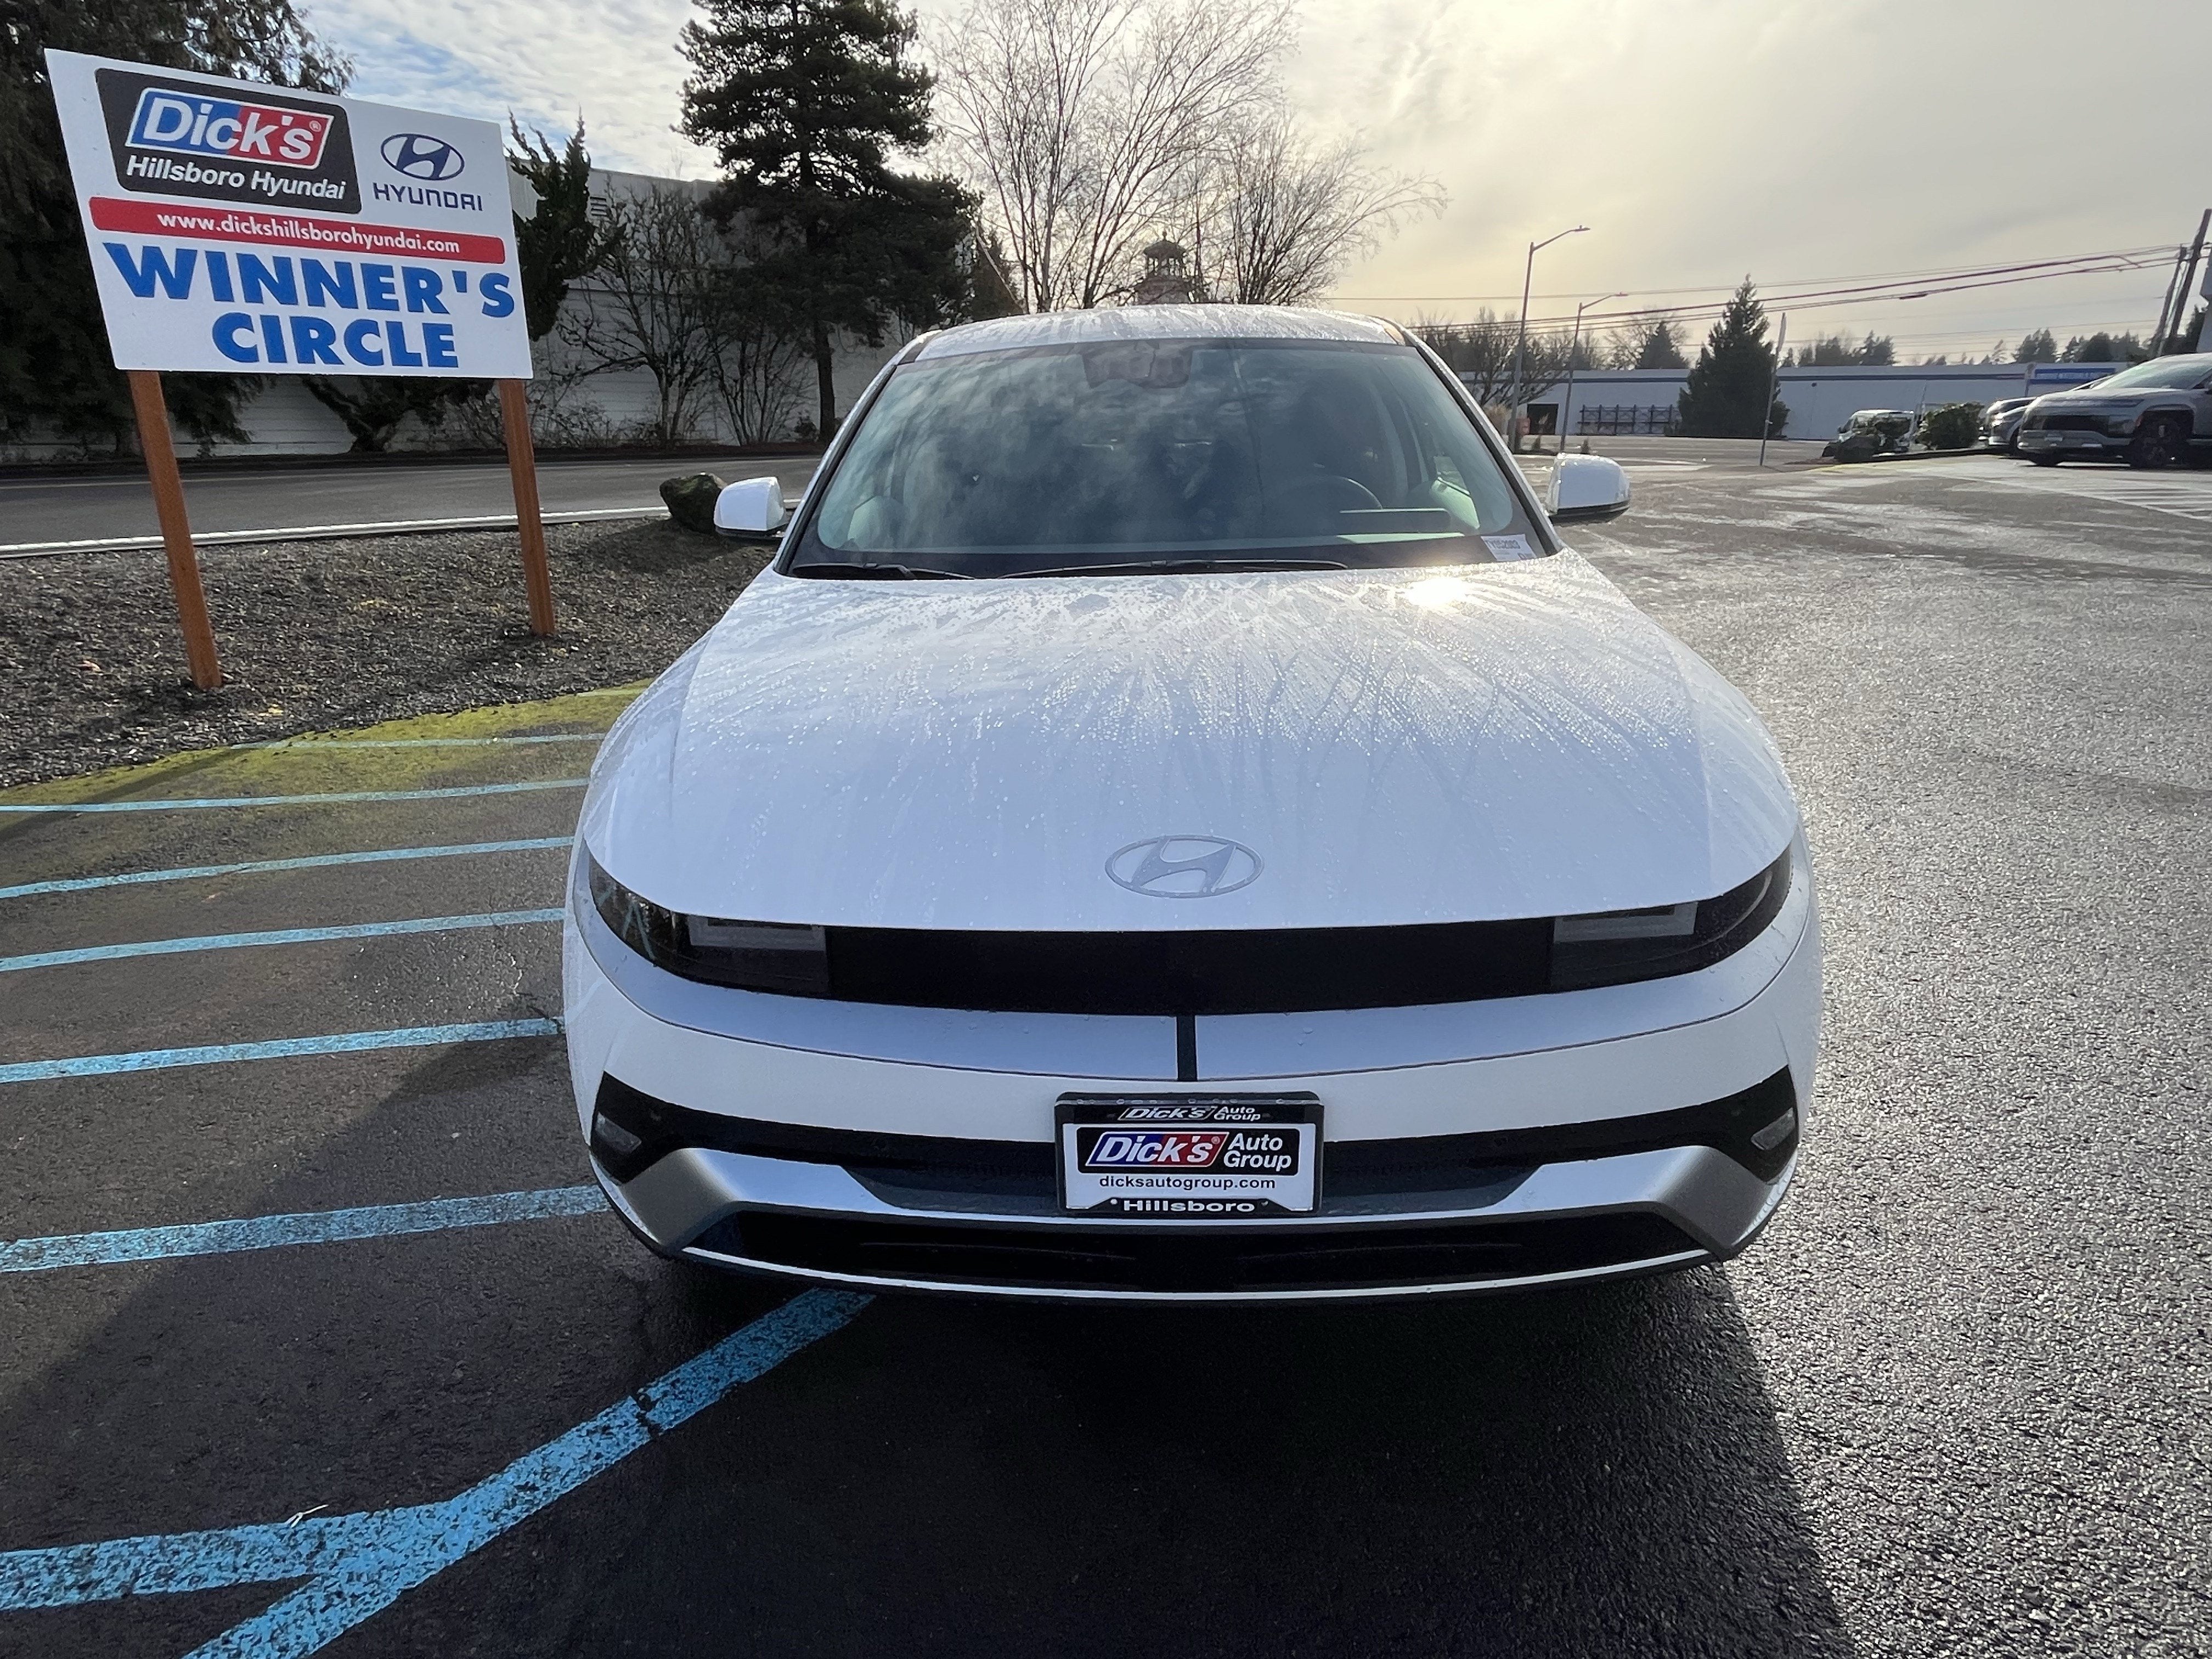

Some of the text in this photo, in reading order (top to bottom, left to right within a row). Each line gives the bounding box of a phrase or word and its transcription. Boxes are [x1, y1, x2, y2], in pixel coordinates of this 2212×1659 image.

[143, 98, 314, 160] Dick's
[127, 156, 345, 201] Hillsboro Hyundai
[374, 183, 483, 211] HYUNDAI
[157, 212, 459, 253] www.dickshillsborohyundai.com
[104, 242, 515, 318] WINNER'S
[212, 312, 459, 368] CIRCLE
[1125, 1107, 1205, 1119] Dick's
[1214, 1113, 1261, 1121] Group
[1218, 1106, 1255, 1114] Auto
[1096, 1136, 1212, 1163] Dick's
[1228, 1133, 1283, 1151] Auto
[1223, 1151, 1291, 1171] Group
[1099, 1176, 1275, 1190] dicksautogroup.com
[1124, 1200, 1255, 1212] Hillsboro
